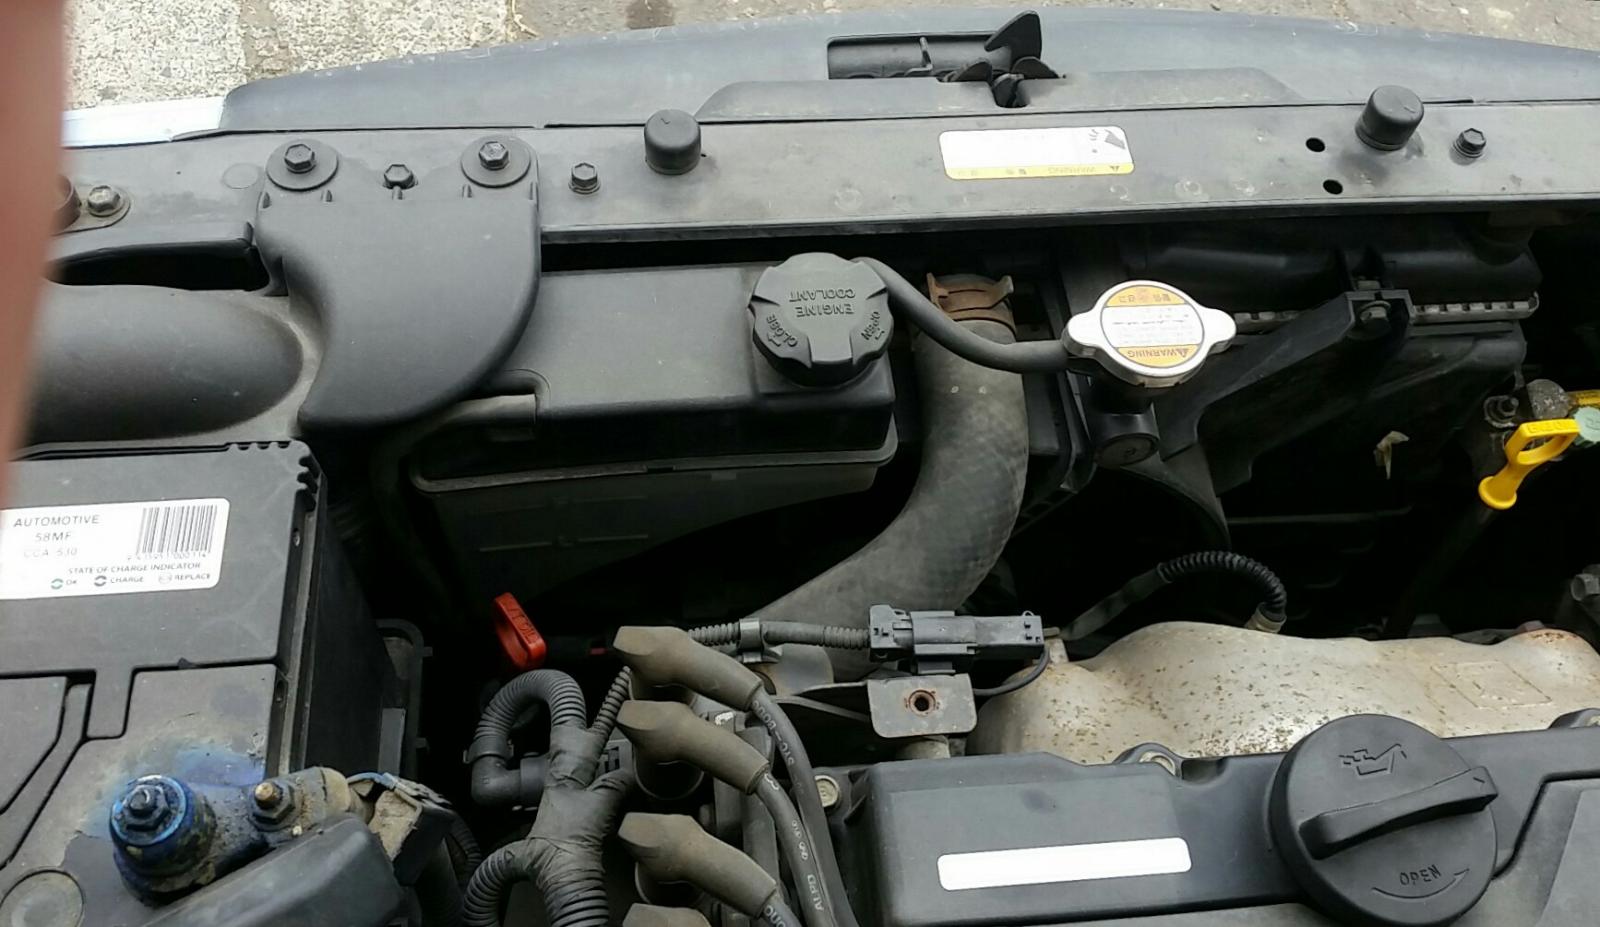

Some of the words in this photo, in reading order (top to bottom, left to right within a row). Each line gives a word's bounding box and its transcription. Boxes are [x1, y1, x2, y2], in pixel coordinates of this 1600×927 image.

[788, 288, 856, 303] COOLANT
[794, 303, 855, 318] ENGINE
[1126, 347, 1177, 359] WARNING
[13, 514, 101, 528] AUTOMOTIVE
[34, 531, 73, 543] 58MF
[68, 566, 94, 575] STATE
[96, 566, 109, 574] OF
[111, 564, 148, 573] CHARGE
[150, 561, 202, 572] INDICATOR
[110, 575, 145, 584] CHARGE
[174, 572, 211, 582] REPLACE
[1399, 864, 1442, 887] OPEN
